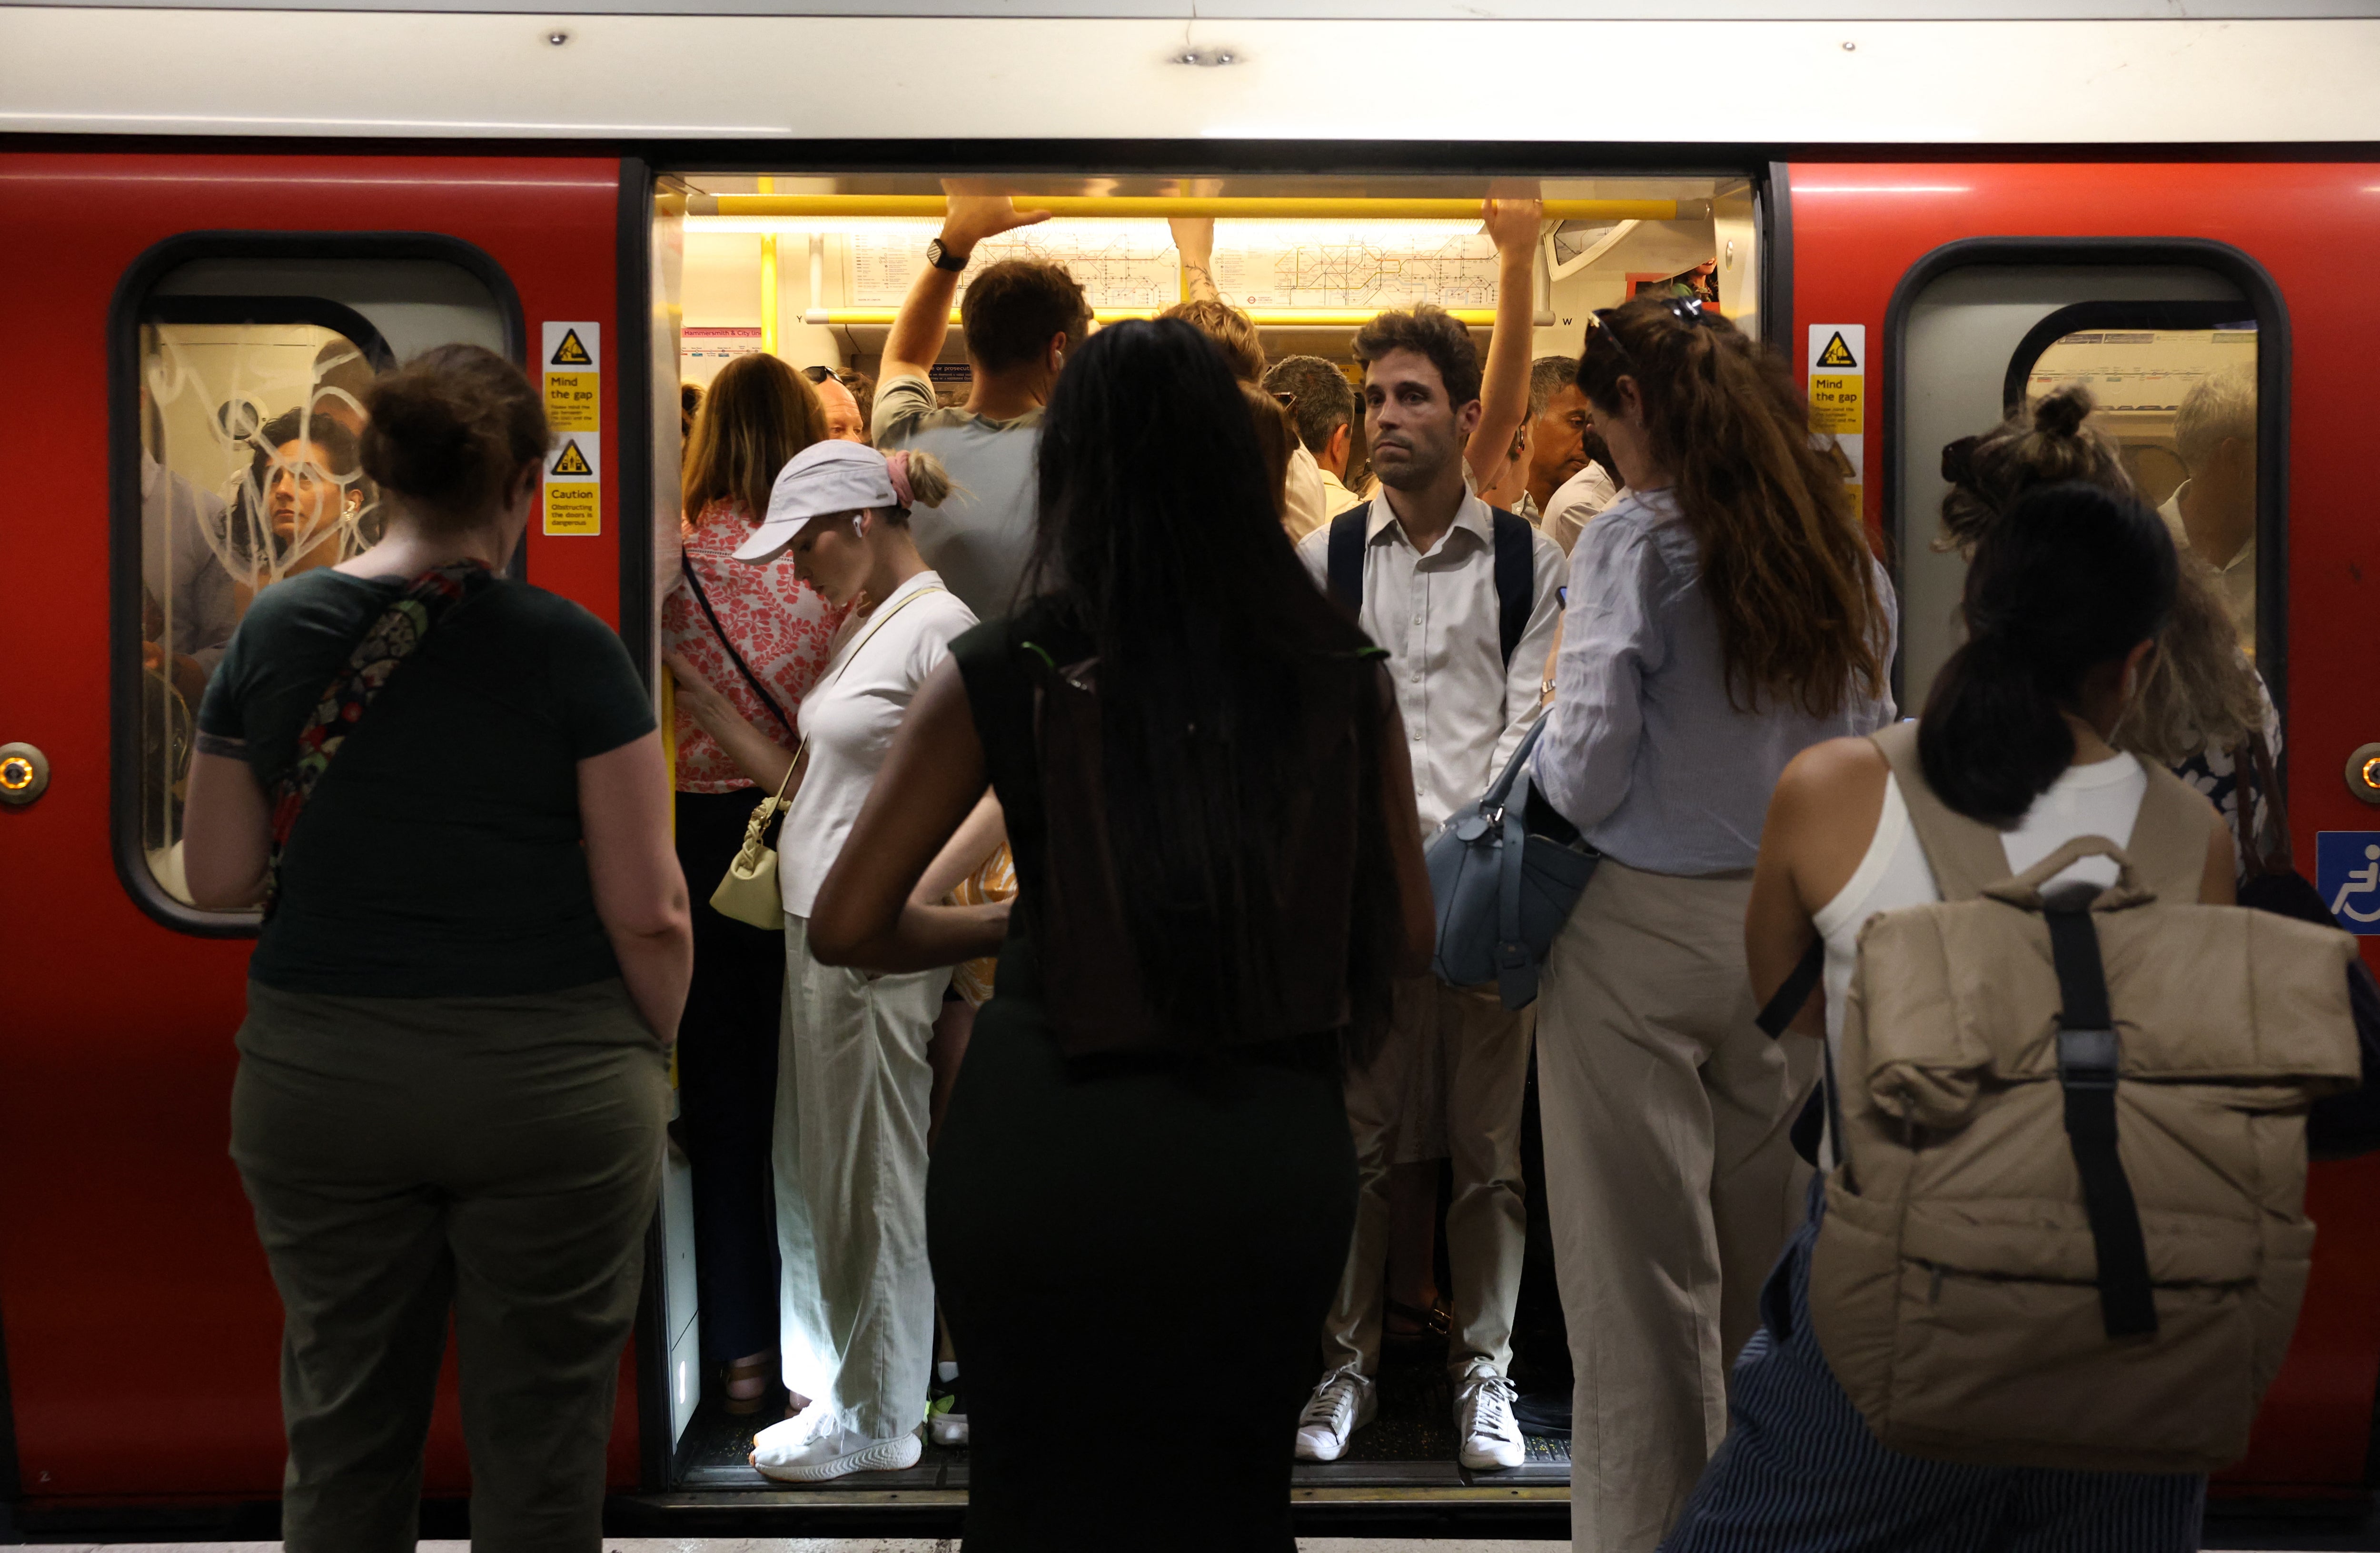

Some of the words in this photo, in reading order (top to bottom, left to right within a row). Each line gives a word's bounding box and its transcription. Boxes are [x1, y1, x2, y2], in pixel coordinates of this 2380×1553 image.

[551, 377, 577, 386] Mind
[1816, 380, 1843, 388] Mind
[551, 390, 570, 398] the
[574, 392, 593, 401] gap
[1816, 393, 1835, 401] the
[1838, 394, 1857, 404] gap
[552, 489, 593, 499] Caution
